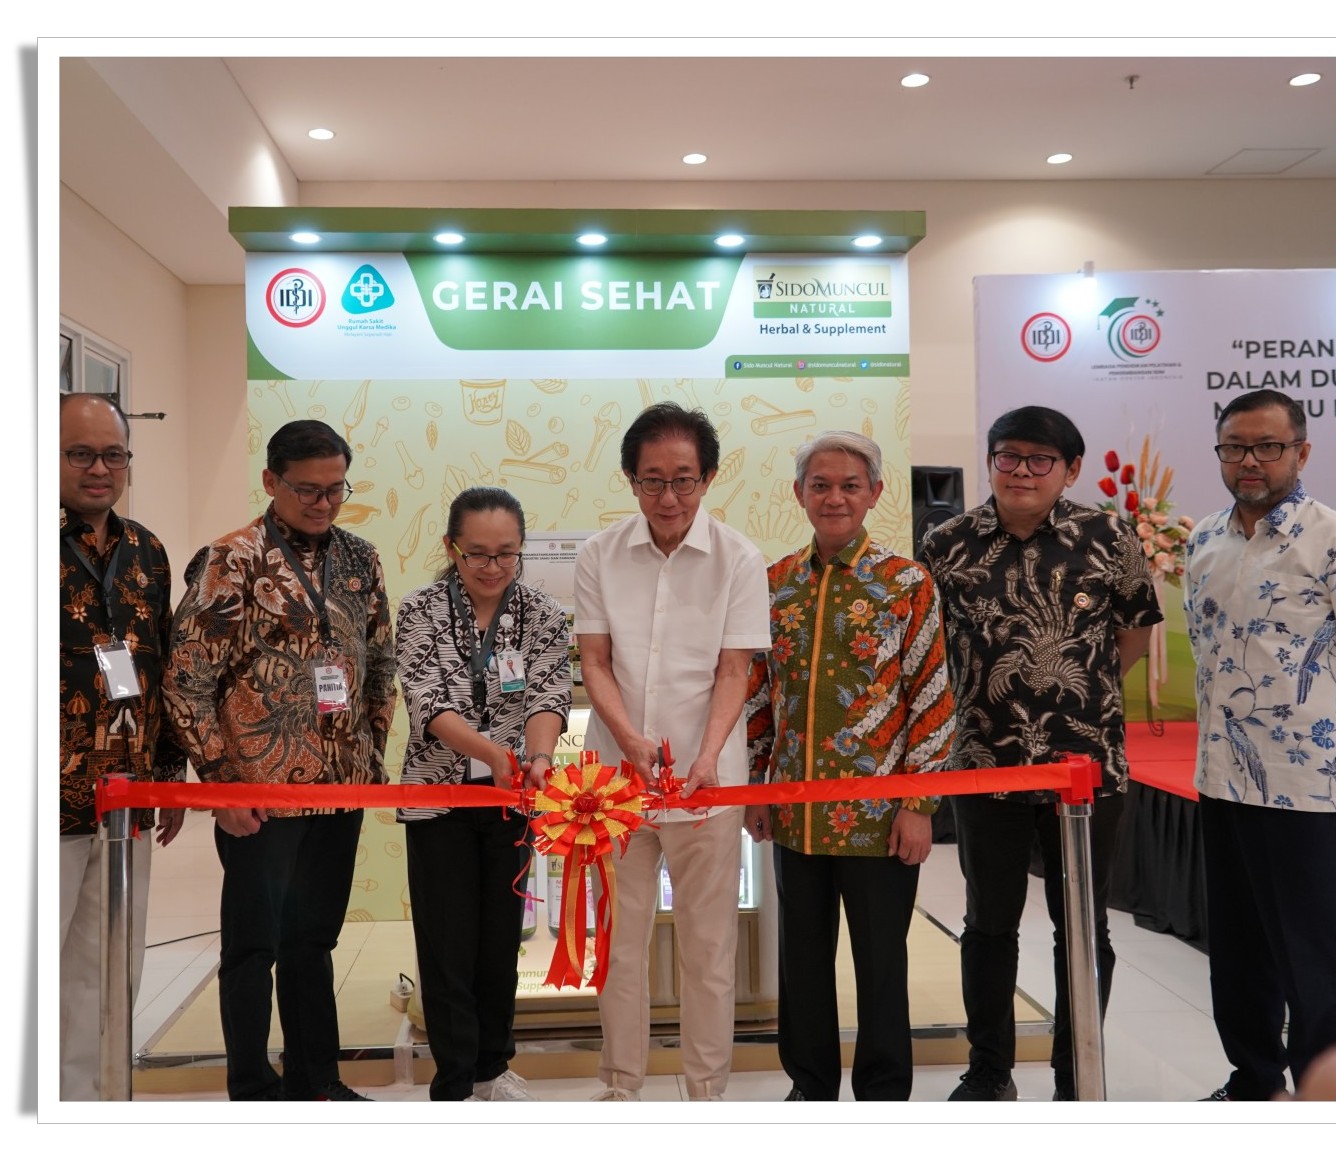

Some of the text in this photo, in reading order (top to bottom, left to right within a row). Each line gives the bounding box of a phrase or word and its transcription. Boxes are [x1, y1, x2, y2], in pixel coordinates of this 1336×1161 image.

[432, 281, 720, 311] GERAI SEHAT
[776, 278, 889, 298] SIDOMUNCUL
[790, 303, 855, 316] NATURAL
[760, 323, 886, 337] Herbal & Supplement
[1207, 370, 1301, 389] DALAM
[318, 682, 343, 693] PANITIA
